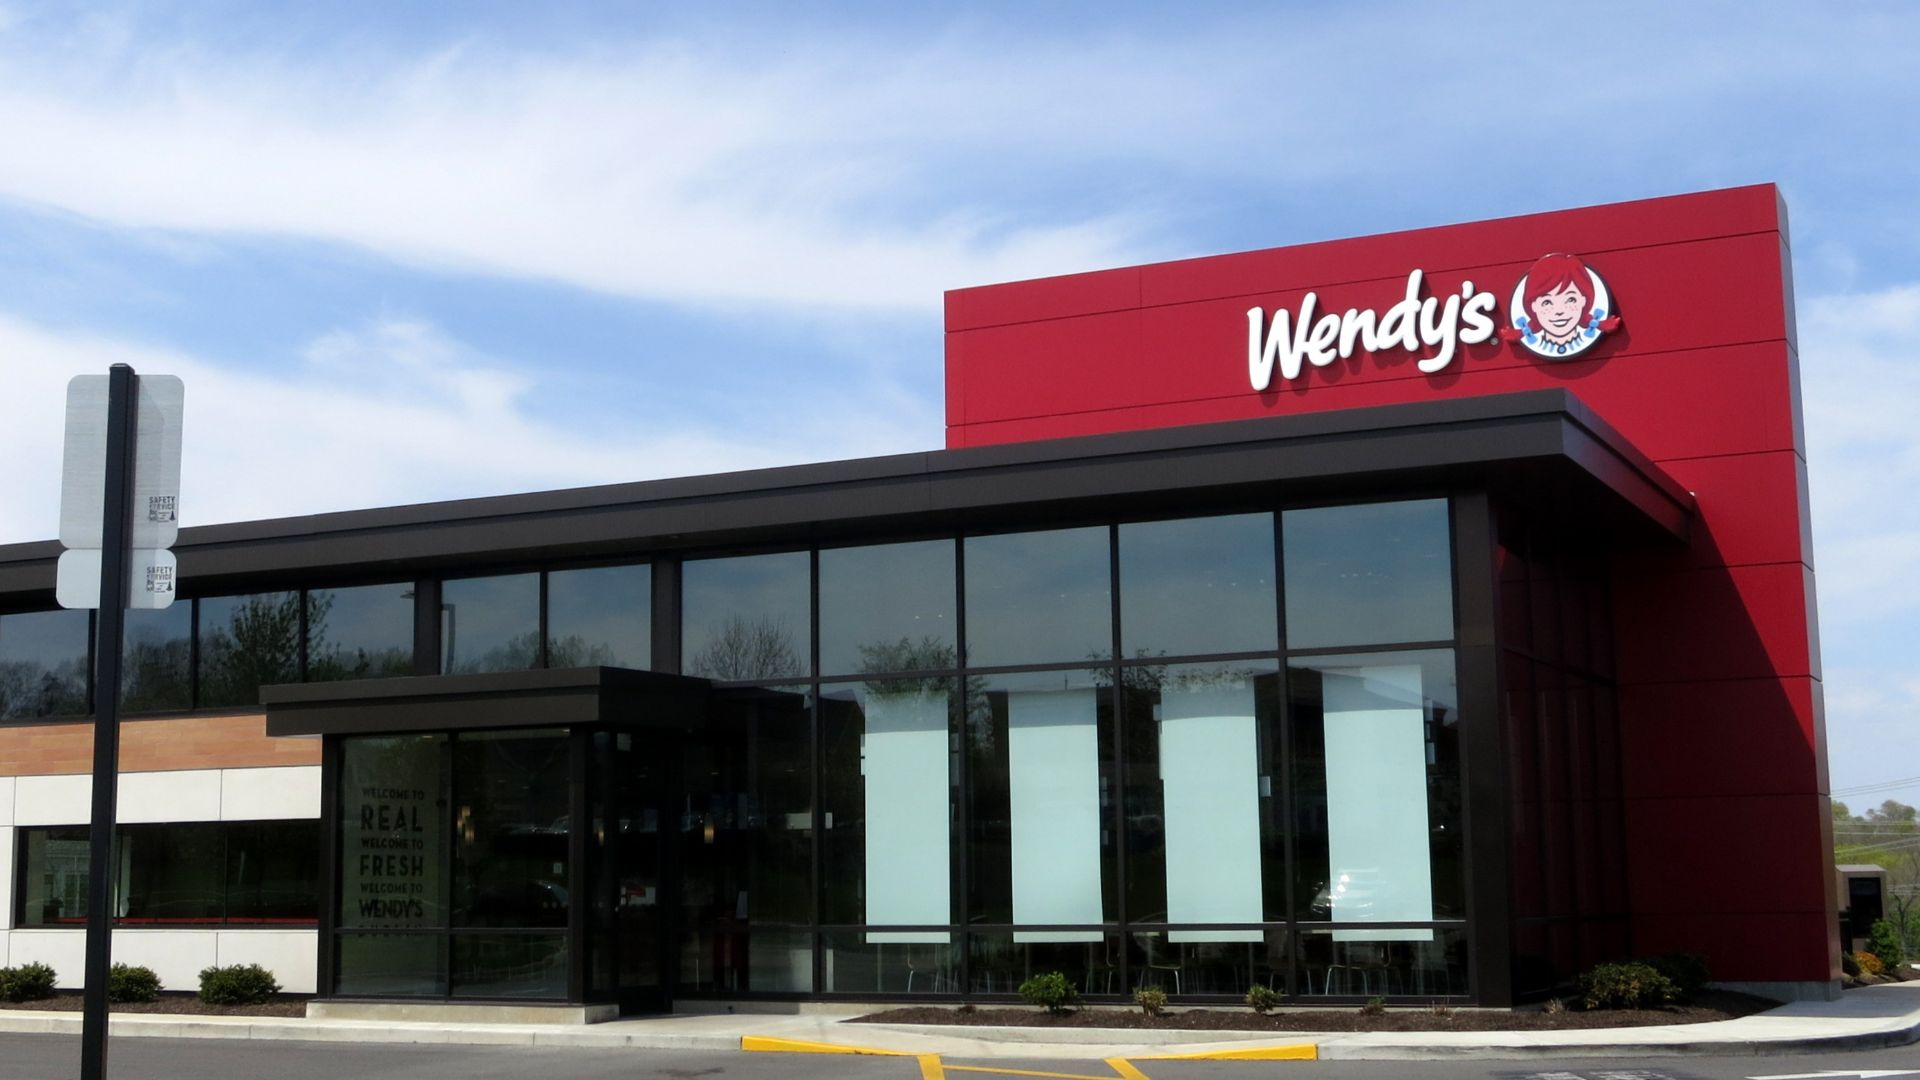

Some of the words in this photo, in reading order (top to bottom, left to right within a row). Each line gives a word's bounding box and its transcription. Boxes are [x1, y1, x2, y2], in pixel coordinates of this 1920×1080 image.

[1247, 268, 1496, 391] Wendy's
[361, 788, 409, 800] WELCOME
[412, 789, 425, 800] TO
[360, 805, 423, 832] REAL
[361, 837, 409, 849] WELCOME
[411, 838, 424, 850] TO
[359, 854, 424, 877] FRESH
[360, 883, 407, 894] WELCOME
[410, 882, 423, 894] TO
[358, 899, 424, 919] WENDY'S
